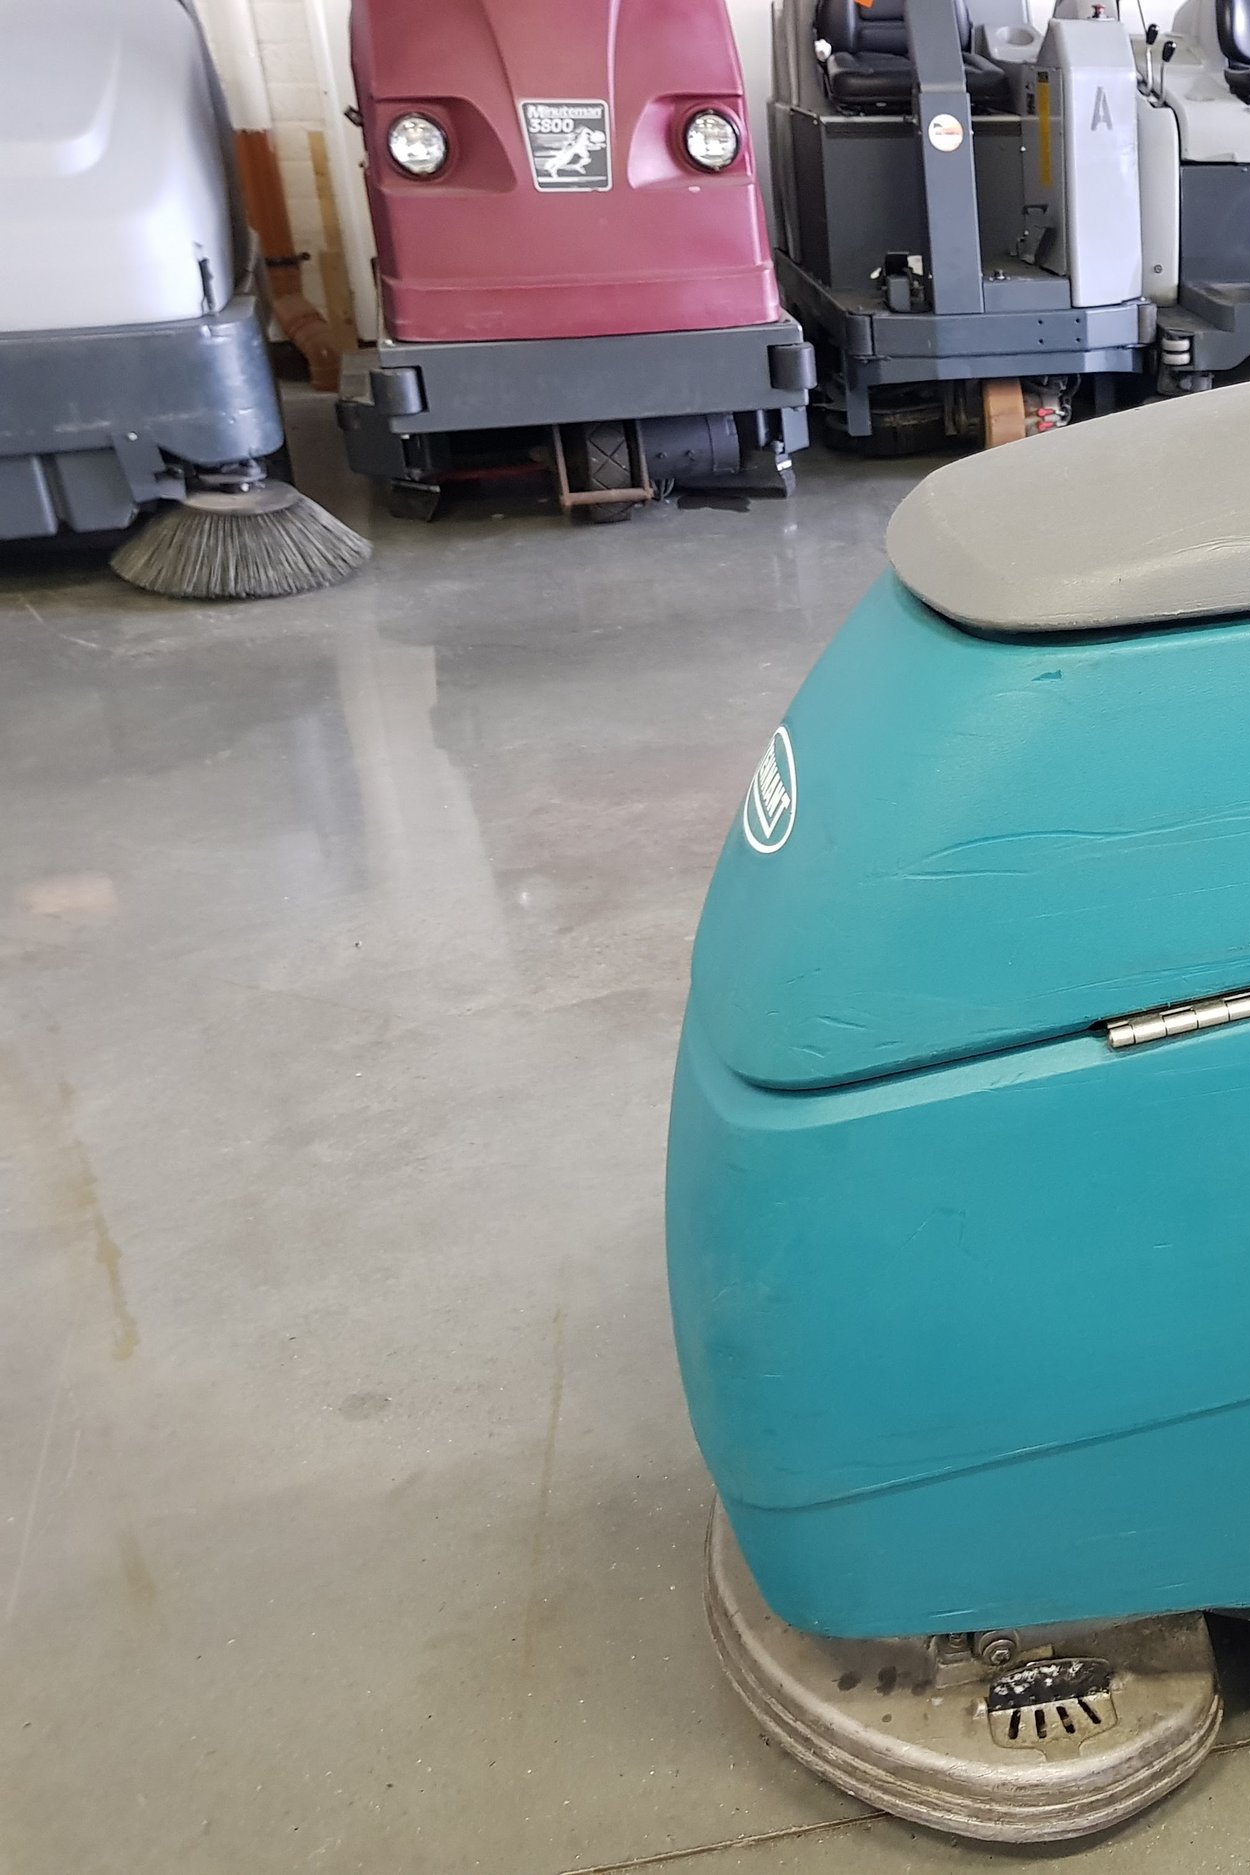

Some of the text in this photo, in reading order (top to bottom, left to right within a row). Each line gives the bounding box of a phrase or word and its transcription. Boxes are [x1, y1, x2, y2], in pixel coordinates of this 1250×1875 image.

[527, 104, 602, 119] Minuteman
[1090, 86, 1113, 131] A
[528, 118, 575, 133] 3800
